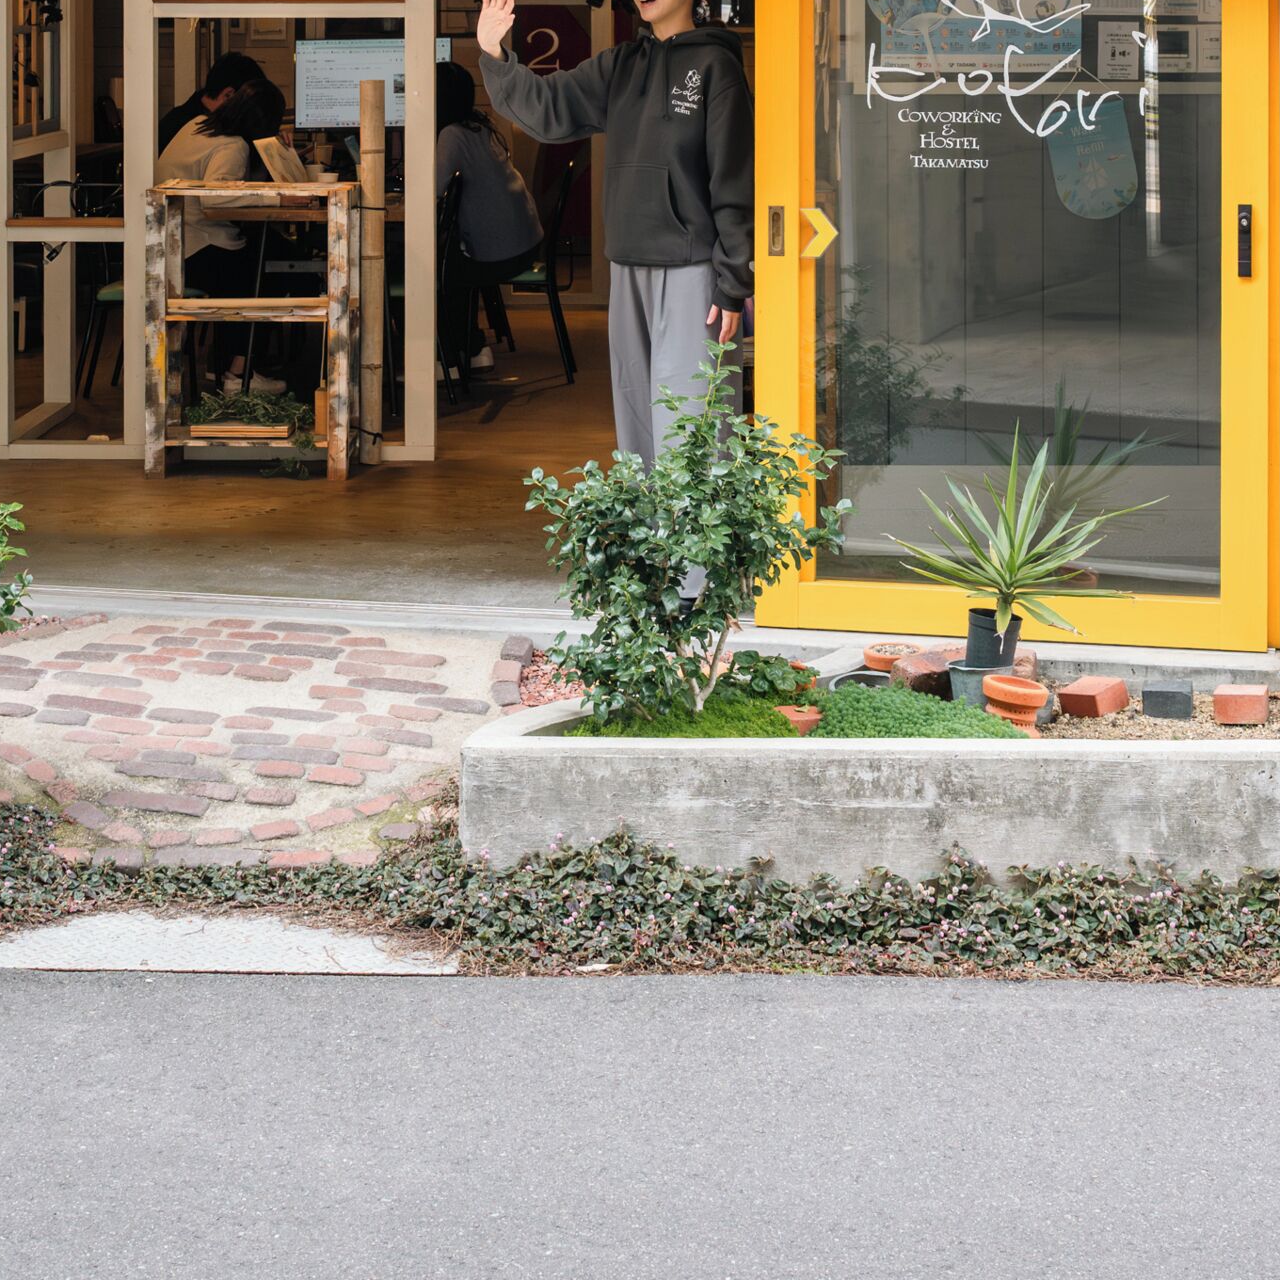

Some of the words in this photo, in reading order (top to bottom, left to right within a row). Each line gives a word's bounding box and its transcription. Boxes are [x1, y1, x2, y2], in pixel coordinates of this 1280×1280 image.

[898, 108, 1002, 124] COWORKING
[942, 123, 955, 136] &
[920, 131, 980, 150] HOSTEL
[910, 154, 989, 169] TAKAMATSU
